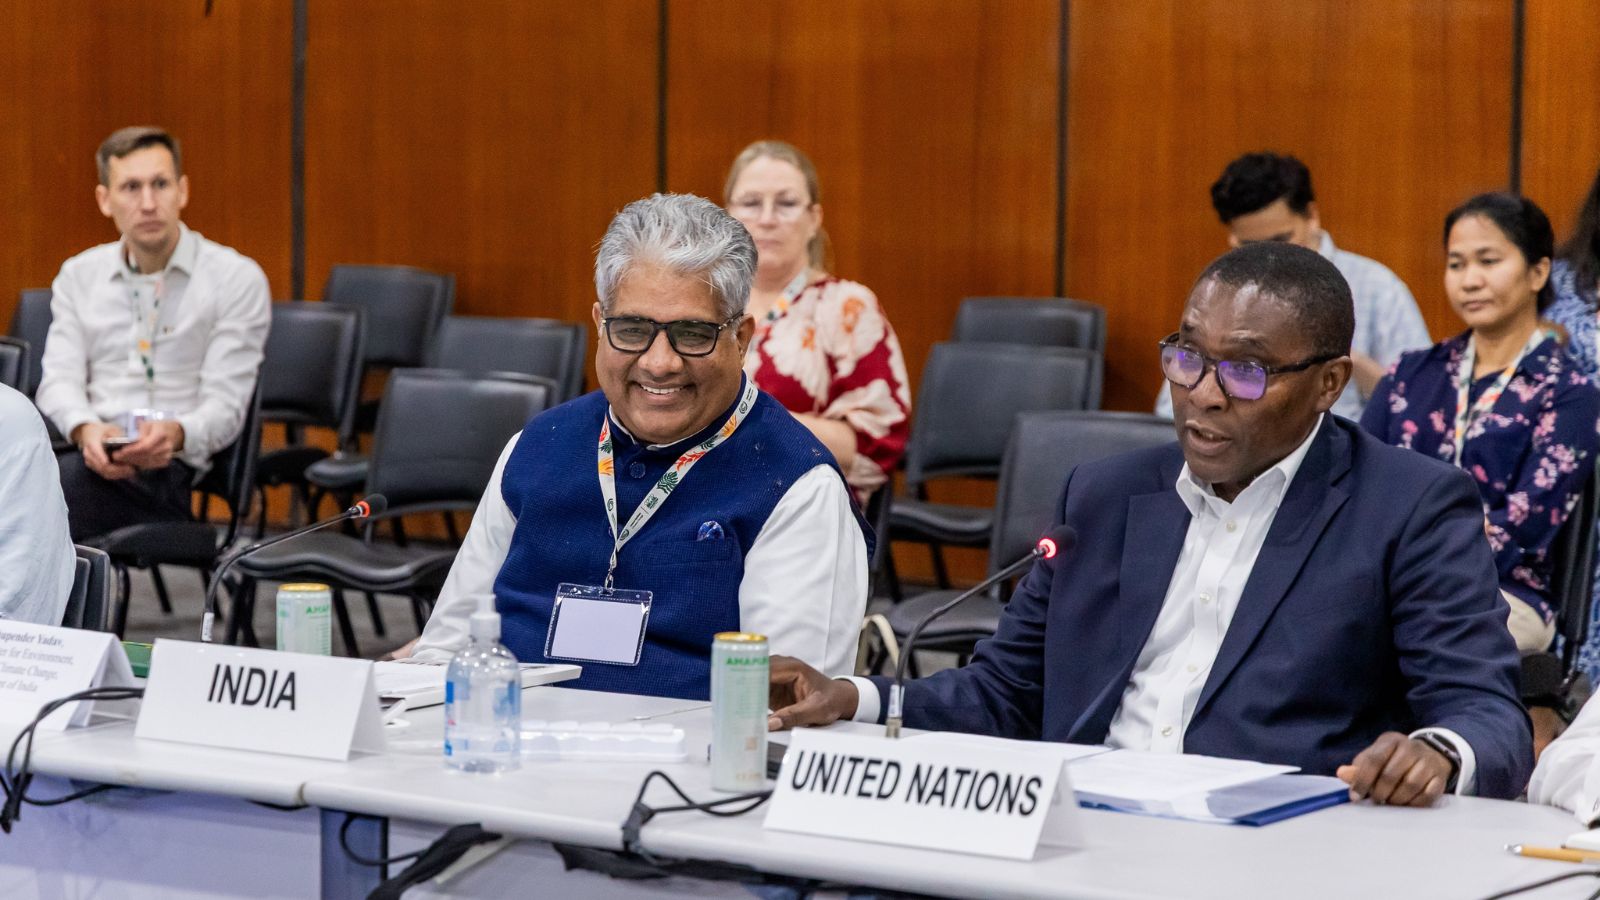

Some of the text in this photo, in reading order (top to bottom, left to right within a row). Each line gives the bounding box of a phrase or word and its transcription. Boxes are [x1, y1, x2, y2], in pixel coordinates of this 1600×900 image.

[0, 631, 35, 642] upender
[207, 663, 296, 711] INDIA
[791, 749, 1042, 816] UNITED NATIONS
